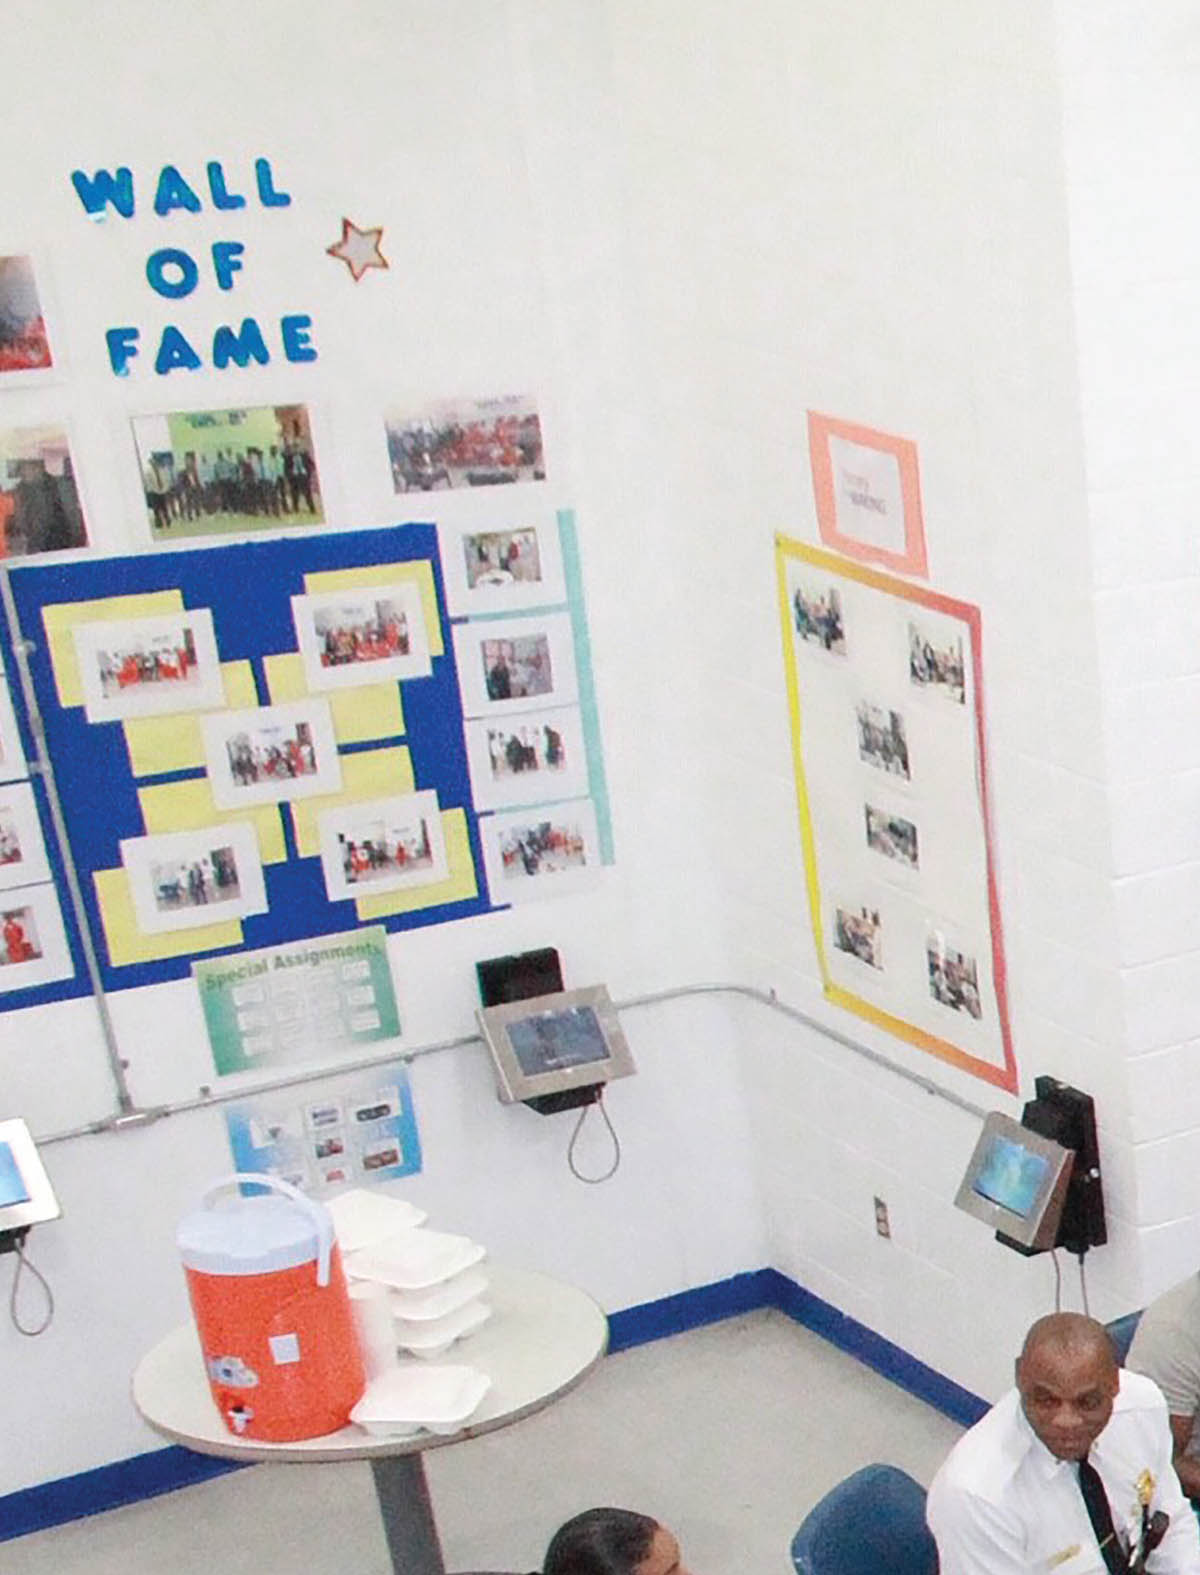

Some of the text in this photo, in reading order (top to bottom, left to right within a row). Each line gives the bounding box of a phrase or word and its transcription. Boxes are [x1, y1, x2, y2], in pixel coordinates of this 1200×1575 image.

[71, 158, 291, 221] WALL
[146, 241, 244, 299] OF
[105, 314, 319, 376] FAME
[205, 941, 383, 991] Special Assignments
